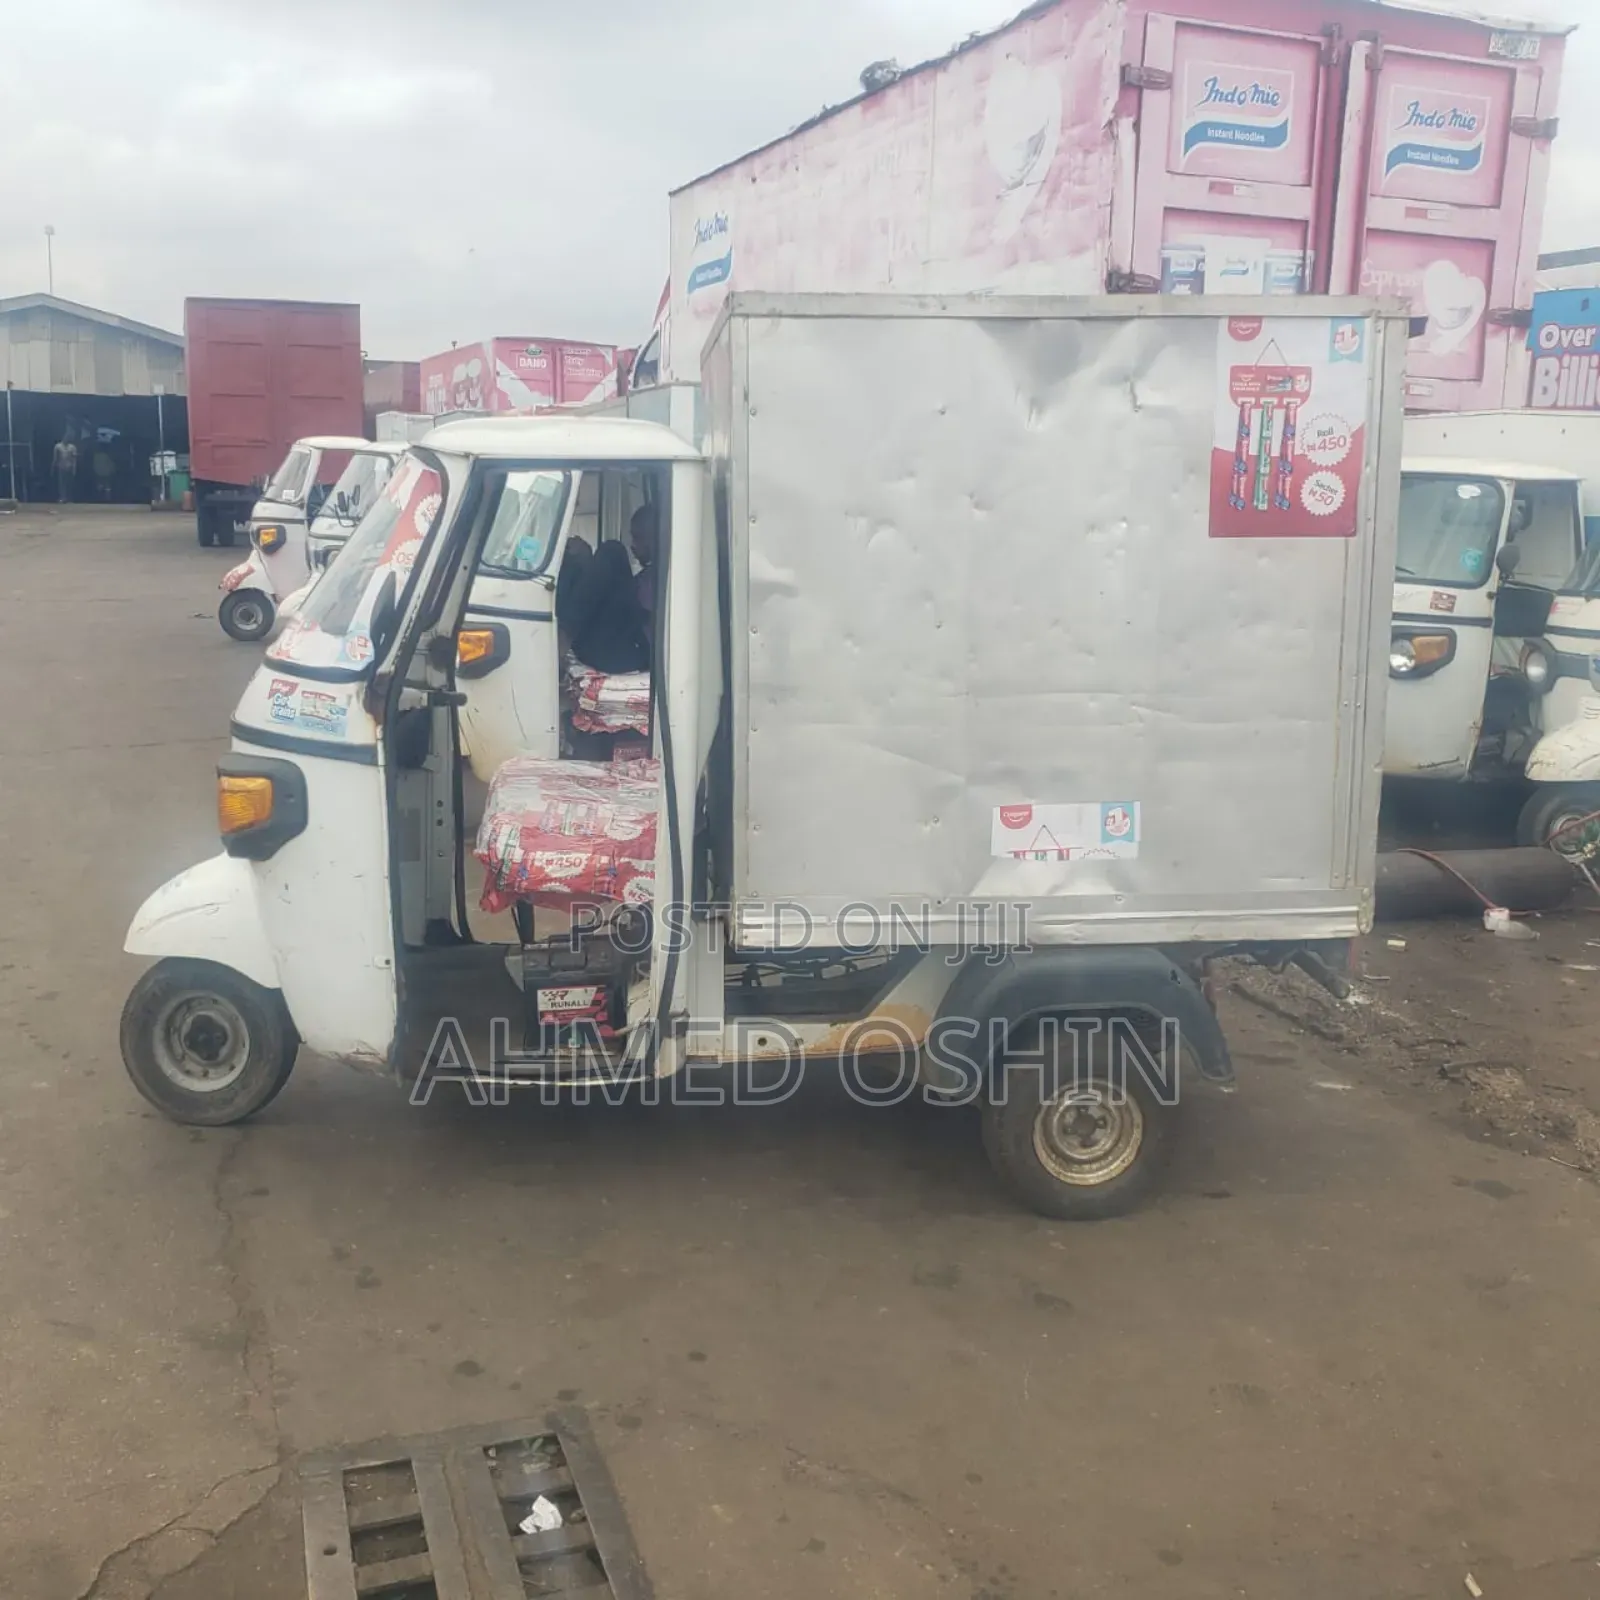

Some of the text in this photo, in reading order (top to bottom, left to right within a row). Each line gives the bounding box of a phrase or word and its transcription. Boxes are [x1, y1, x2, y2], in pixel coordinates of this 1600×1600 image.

[1207, 128, 1265, 142] Instant Noodles
[1539, 323, 1596, 350] Over
[1532, 354, 1600, 407] Billi
[550, 1000, 588, 1008] RUNALL
